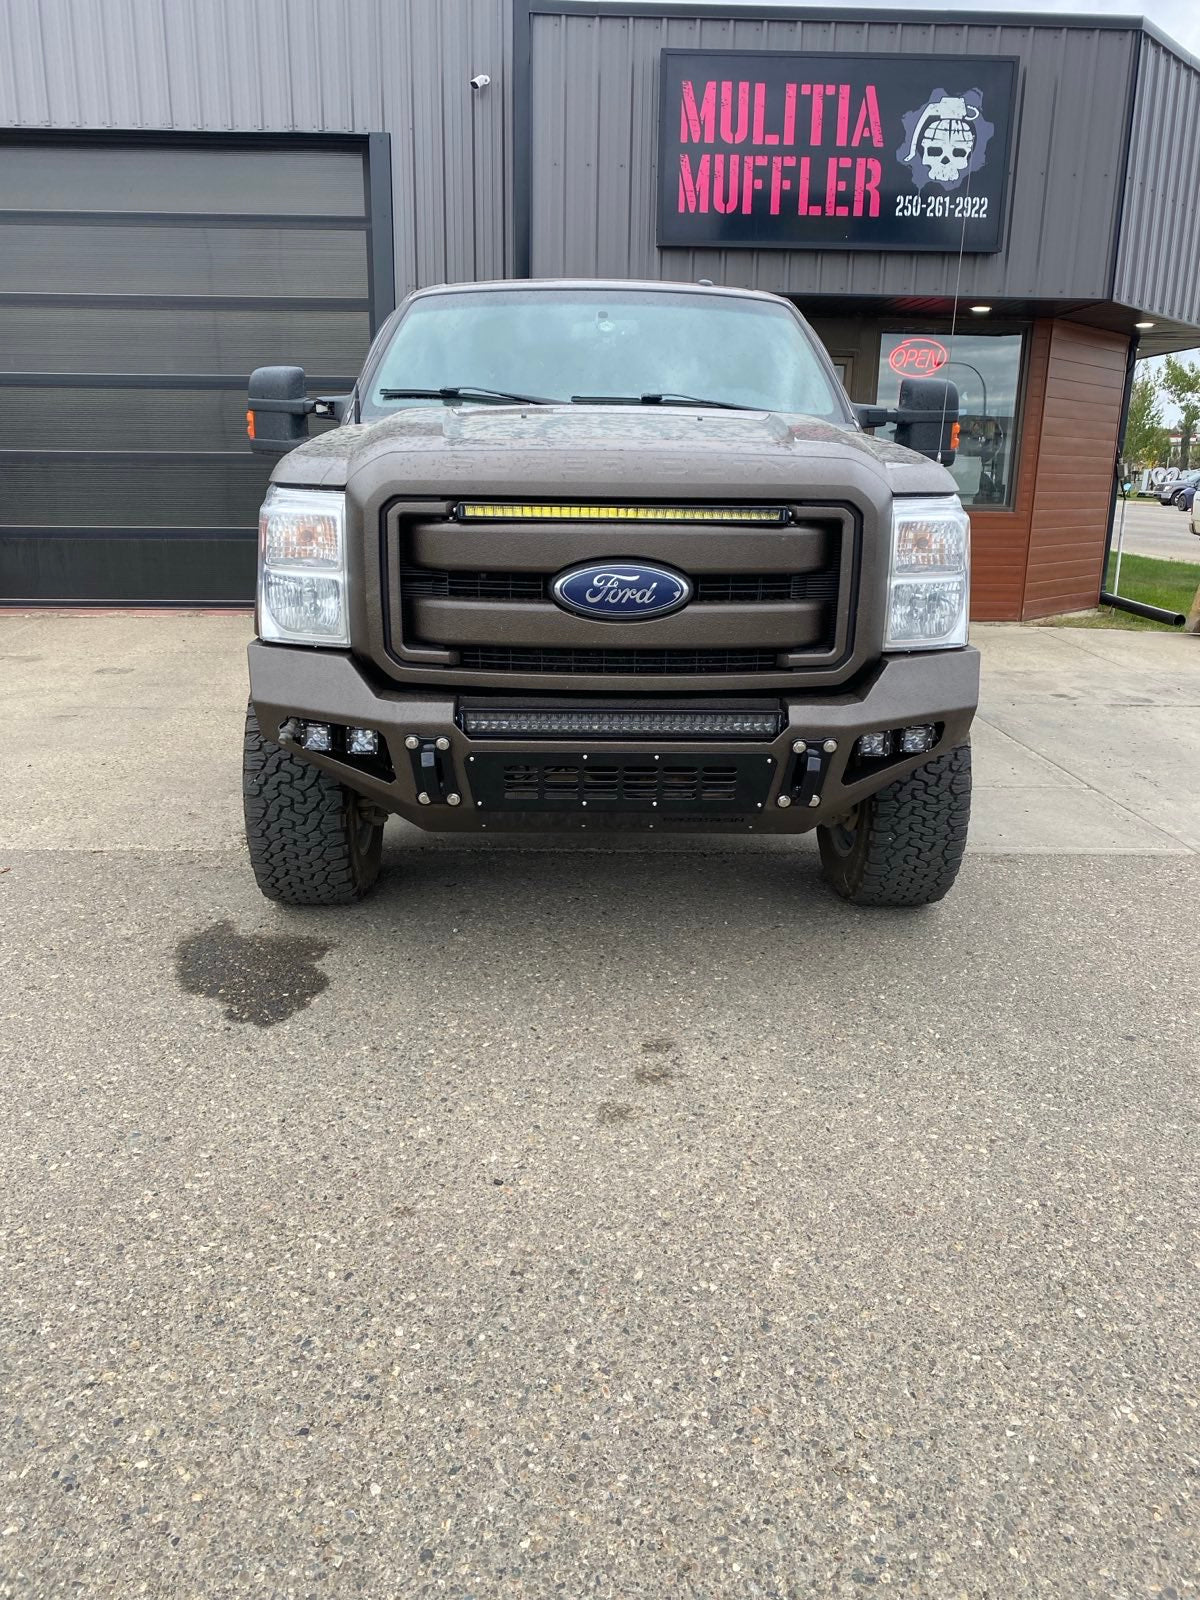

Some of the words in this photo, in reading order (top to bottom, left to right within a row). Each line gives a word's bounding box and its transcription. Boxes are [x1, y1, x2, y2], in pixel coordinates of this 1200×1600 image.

[679, 80, 884, 147] MULITIA
[678, 154, 882, 217] MUFFLER
[895, 195, 989, 218] 250-261-2922
[892, 349, 942, 368] OPEN
[585, 573, 658, 604] Ford
